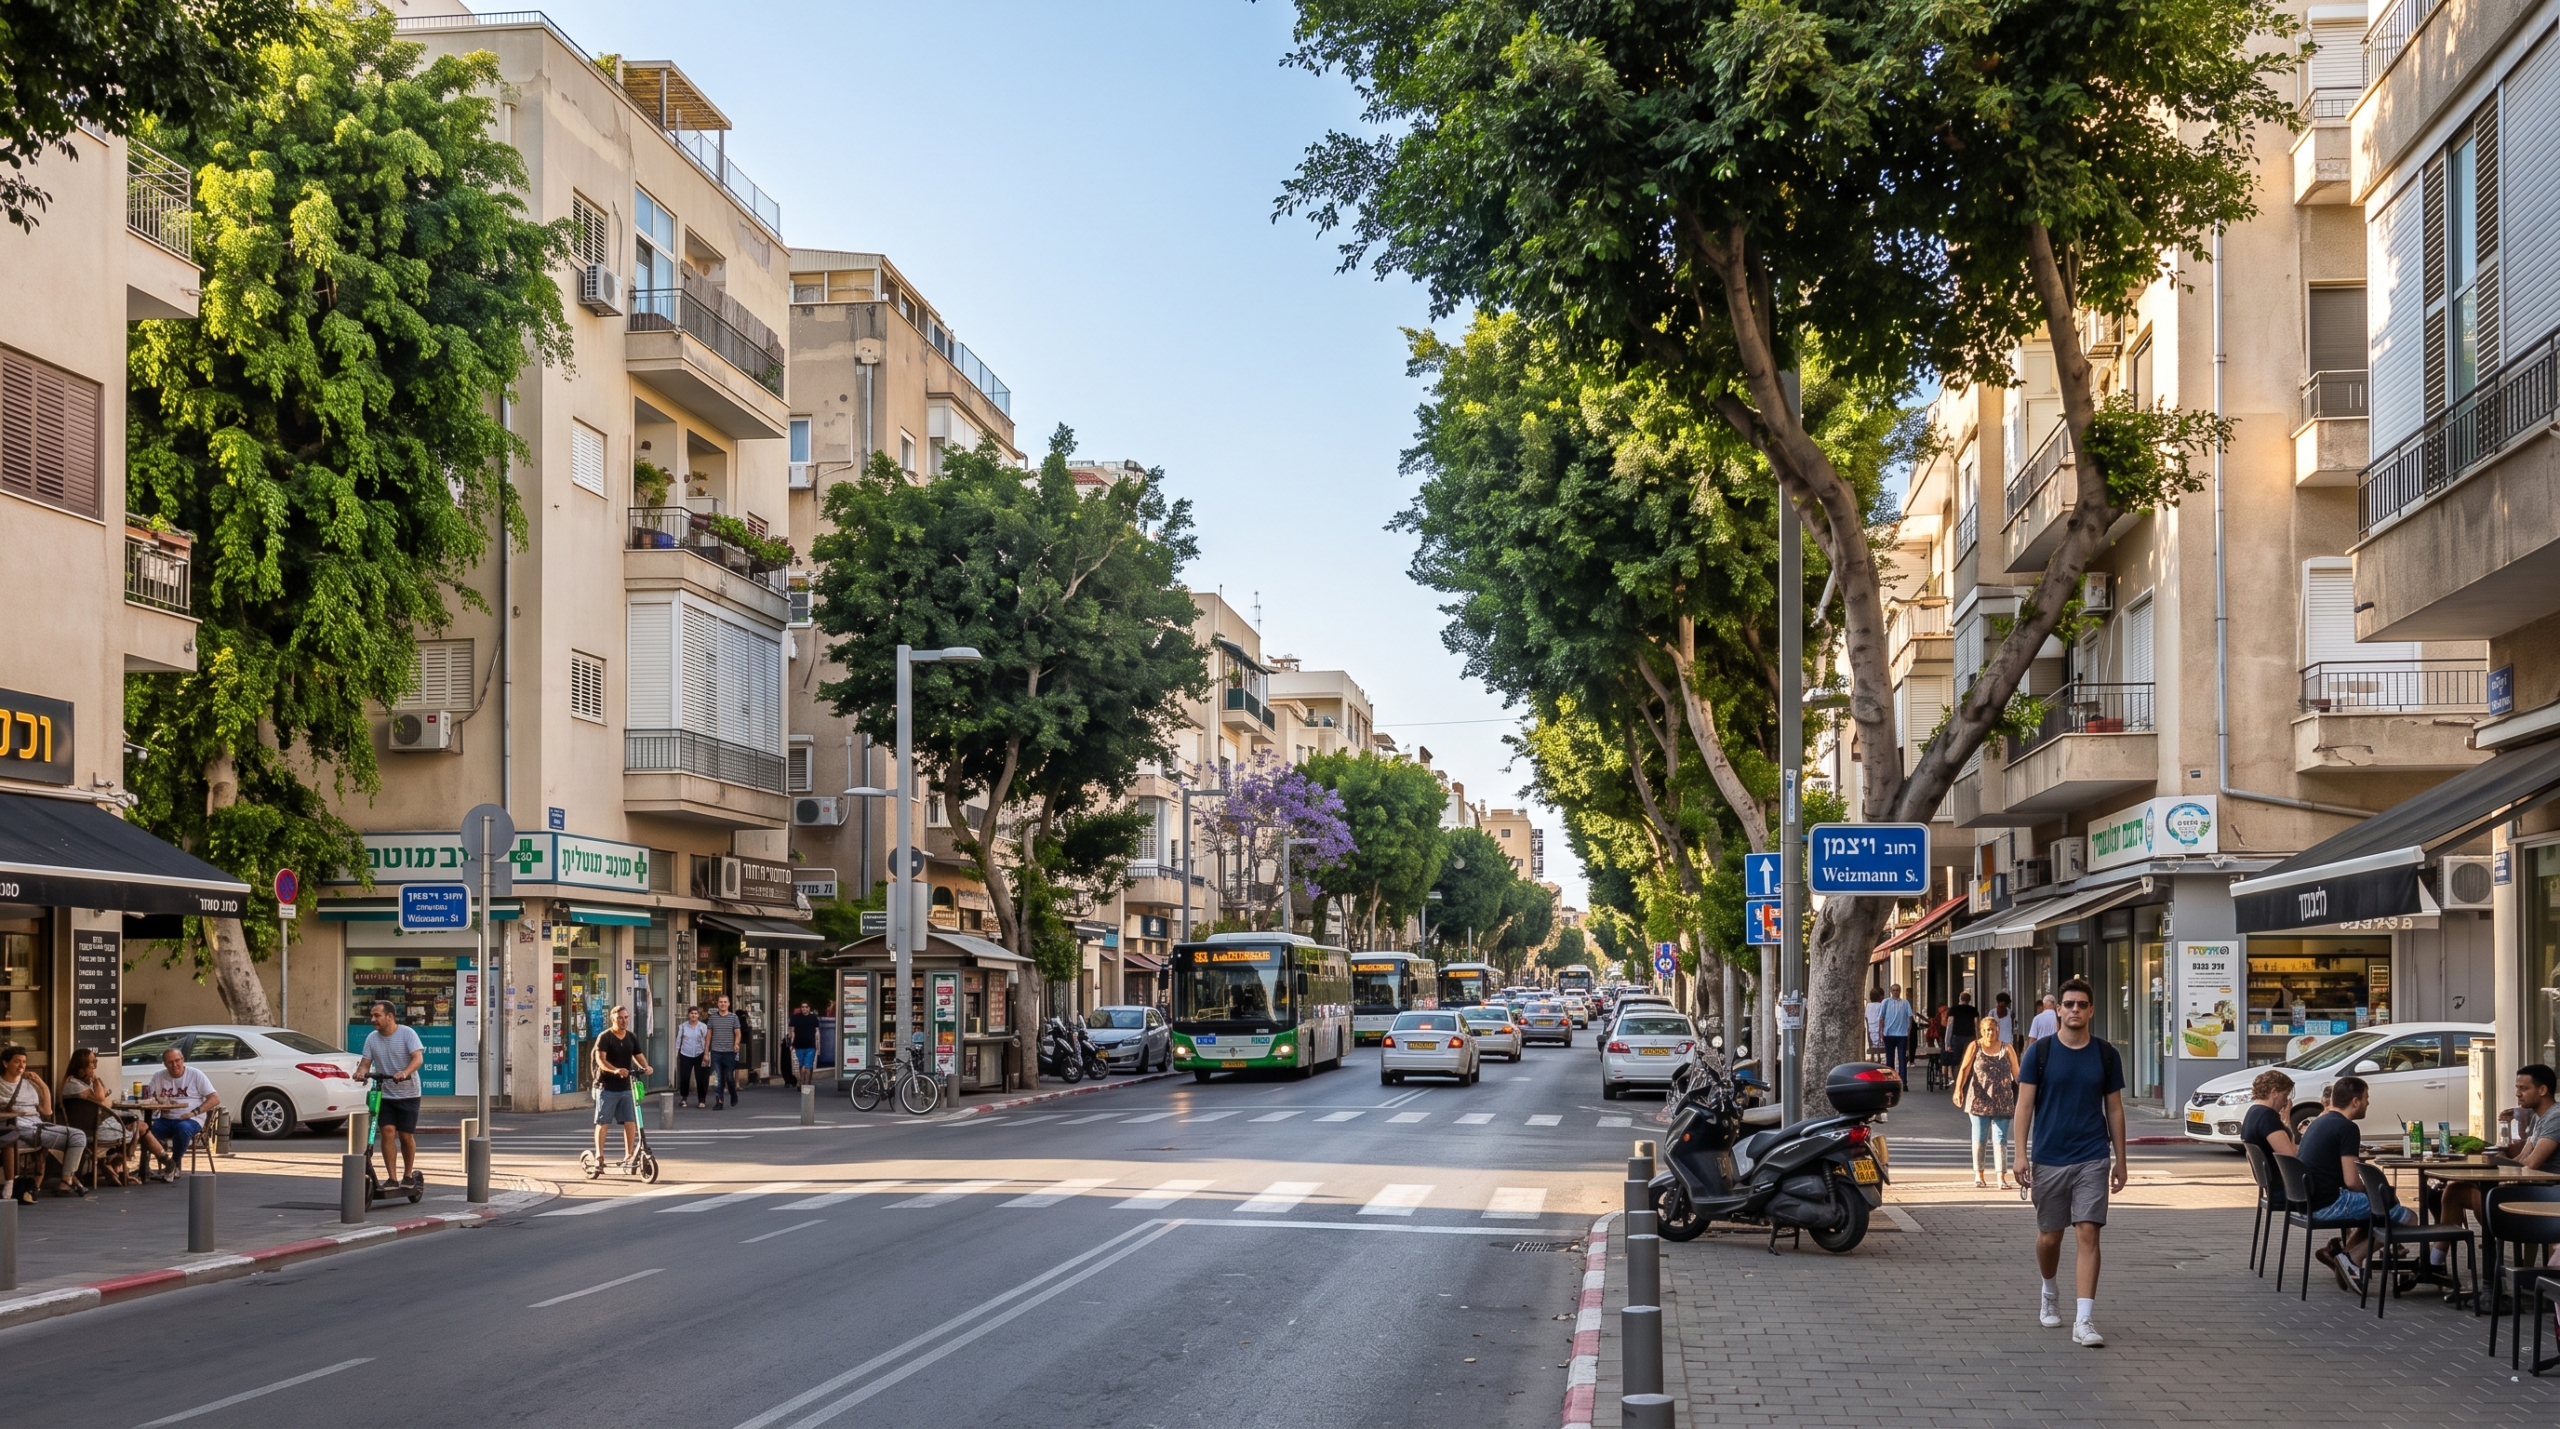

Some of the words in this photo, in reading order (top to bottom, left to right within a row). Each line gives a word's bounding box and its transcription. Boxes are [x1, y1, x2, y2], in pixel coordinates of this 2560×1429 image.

[1823, 837, 1876, 861] ויצמן
[1884, 843, 1916, 855] רחוב
[1822, 867, 1898, 882] Weizmann
